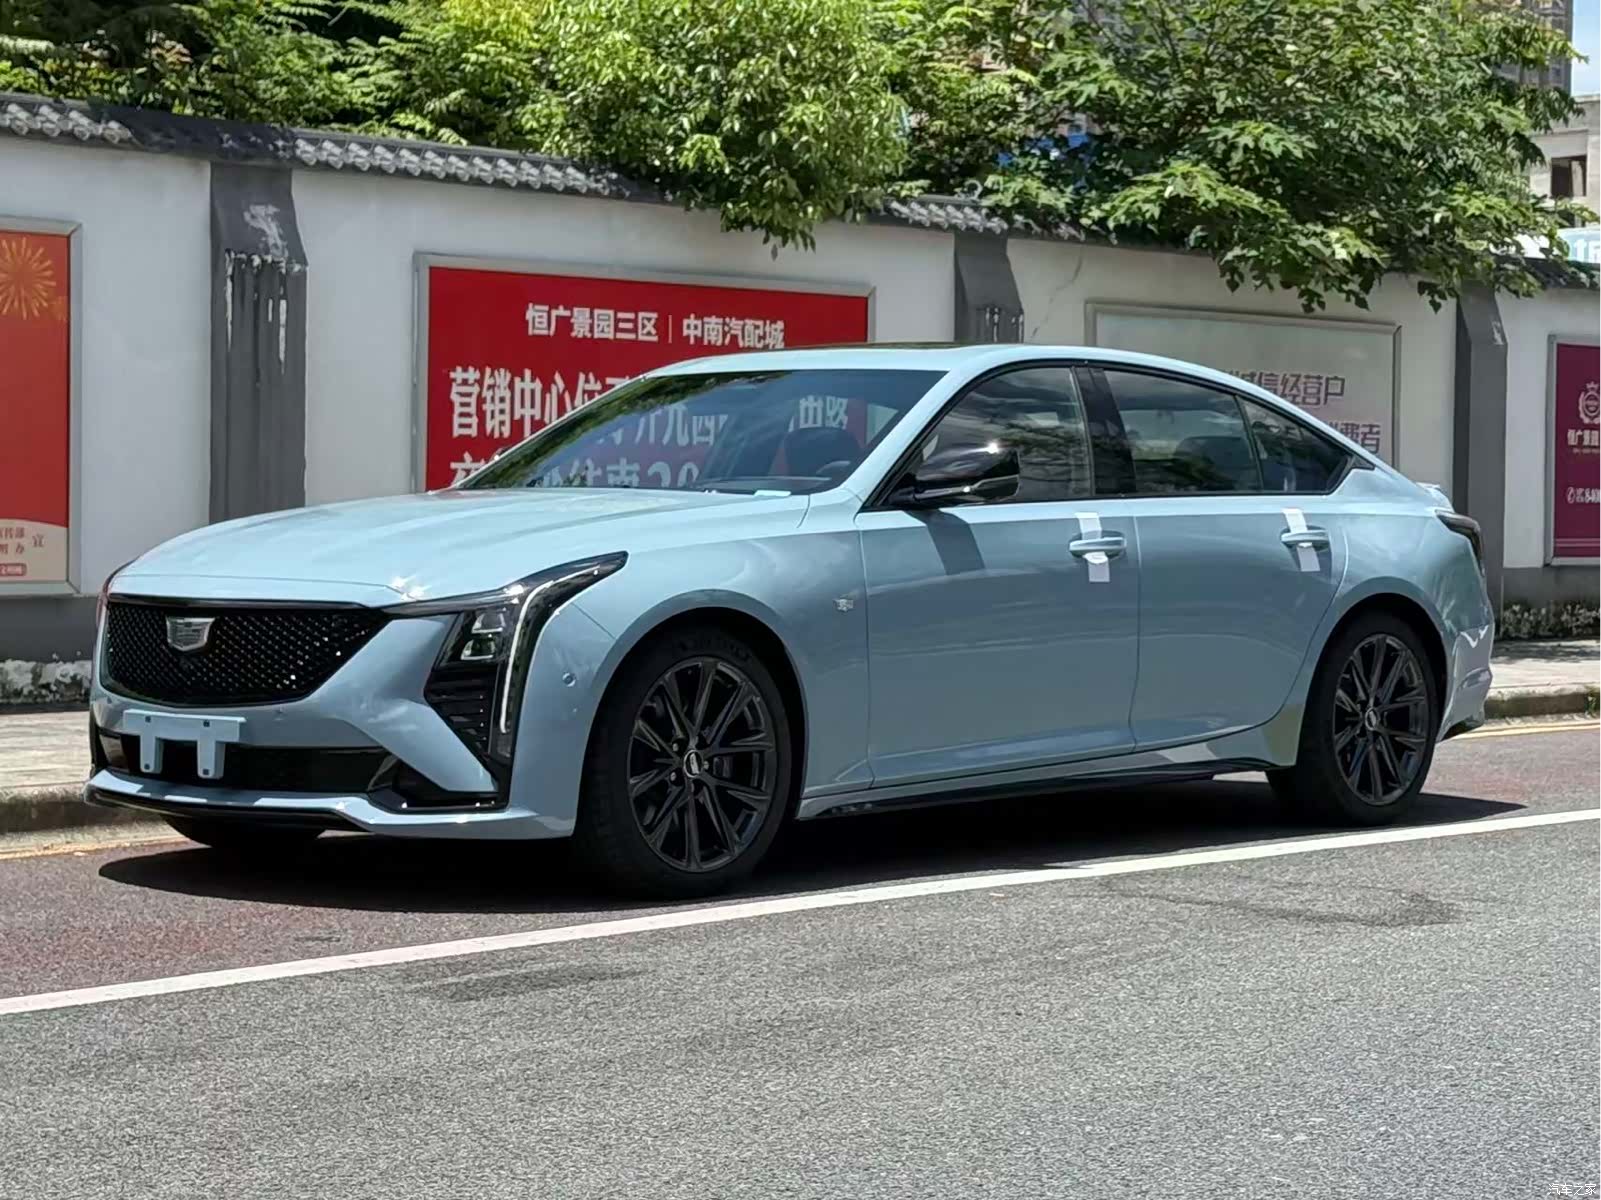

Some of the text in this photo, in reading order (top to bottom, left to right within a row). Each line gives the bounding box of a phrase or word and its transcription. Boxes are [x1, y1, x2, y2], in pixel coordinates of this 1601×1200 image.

[525, 303, 785, 349] 恒广景园三区 中南汽配城
[1326, 421, 1381, 454] 费者
